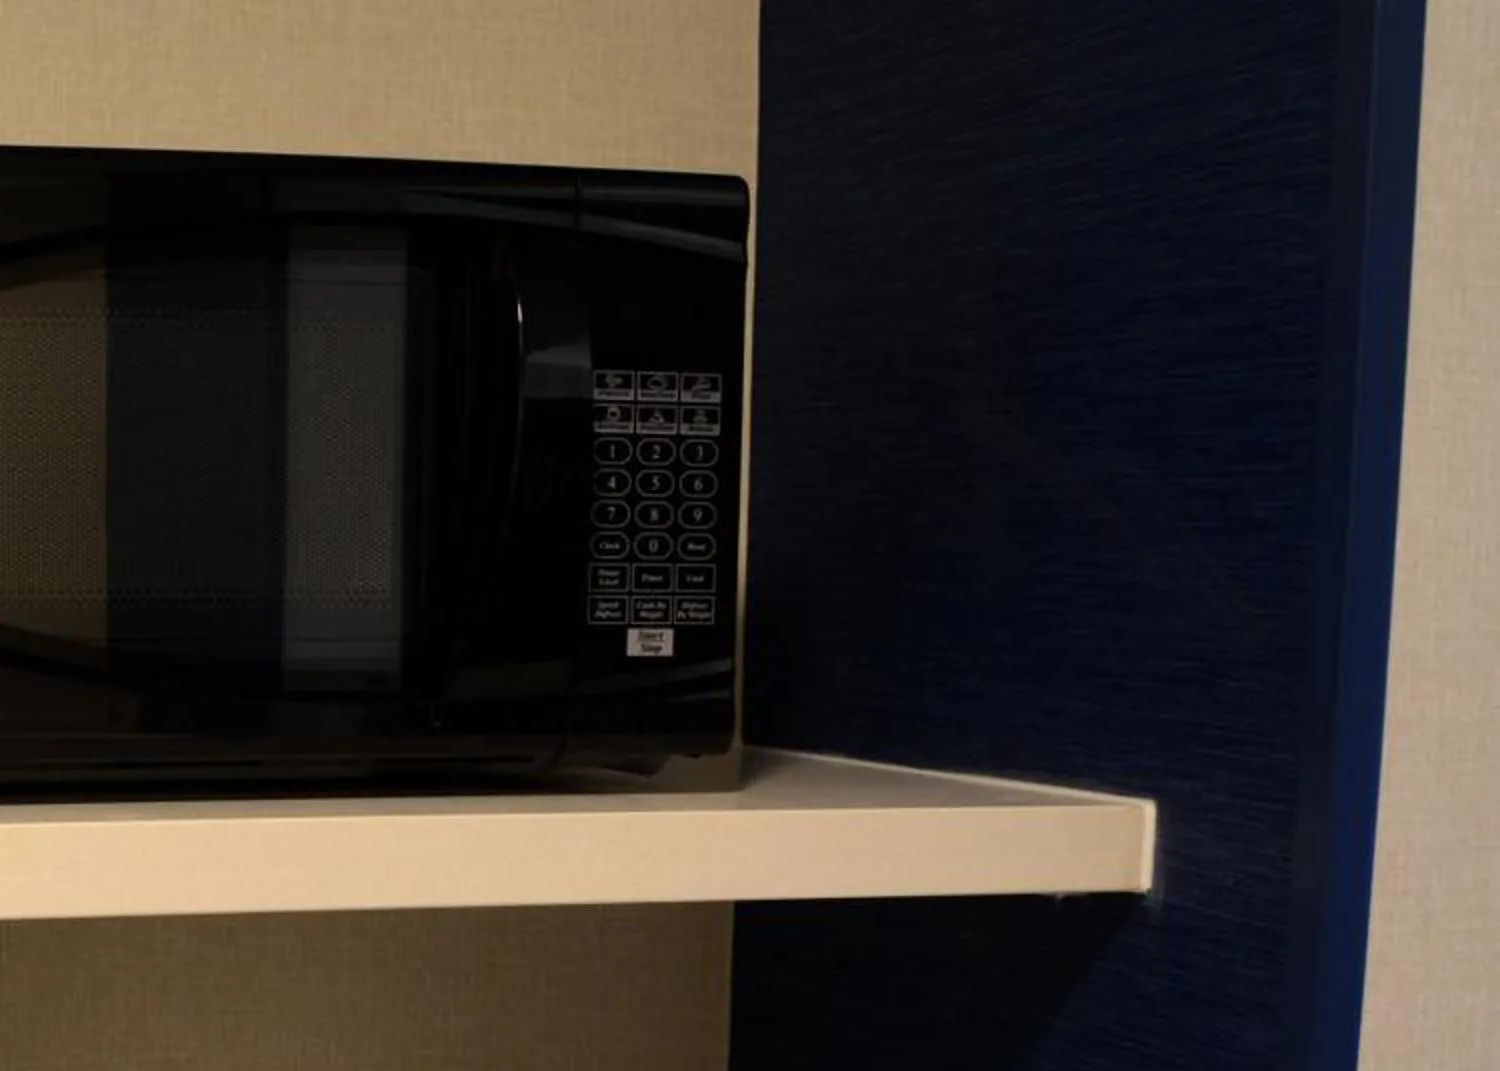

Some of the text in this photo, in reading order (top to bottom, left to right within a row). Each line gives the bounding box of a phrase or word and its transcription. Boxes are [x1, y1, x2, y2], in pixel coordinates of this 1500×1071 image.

[608, 443, 617, 460] 1
[651, 443, 661, 460] 2
[606, 475, 617, 490] 4
[650, 475, 661, 491] 5
[693, 476, 704, 492] 6
[606, 505, 617, 522] 7
[692, 507, 704, 523] 9
[648, 538, 660, 554] 0
